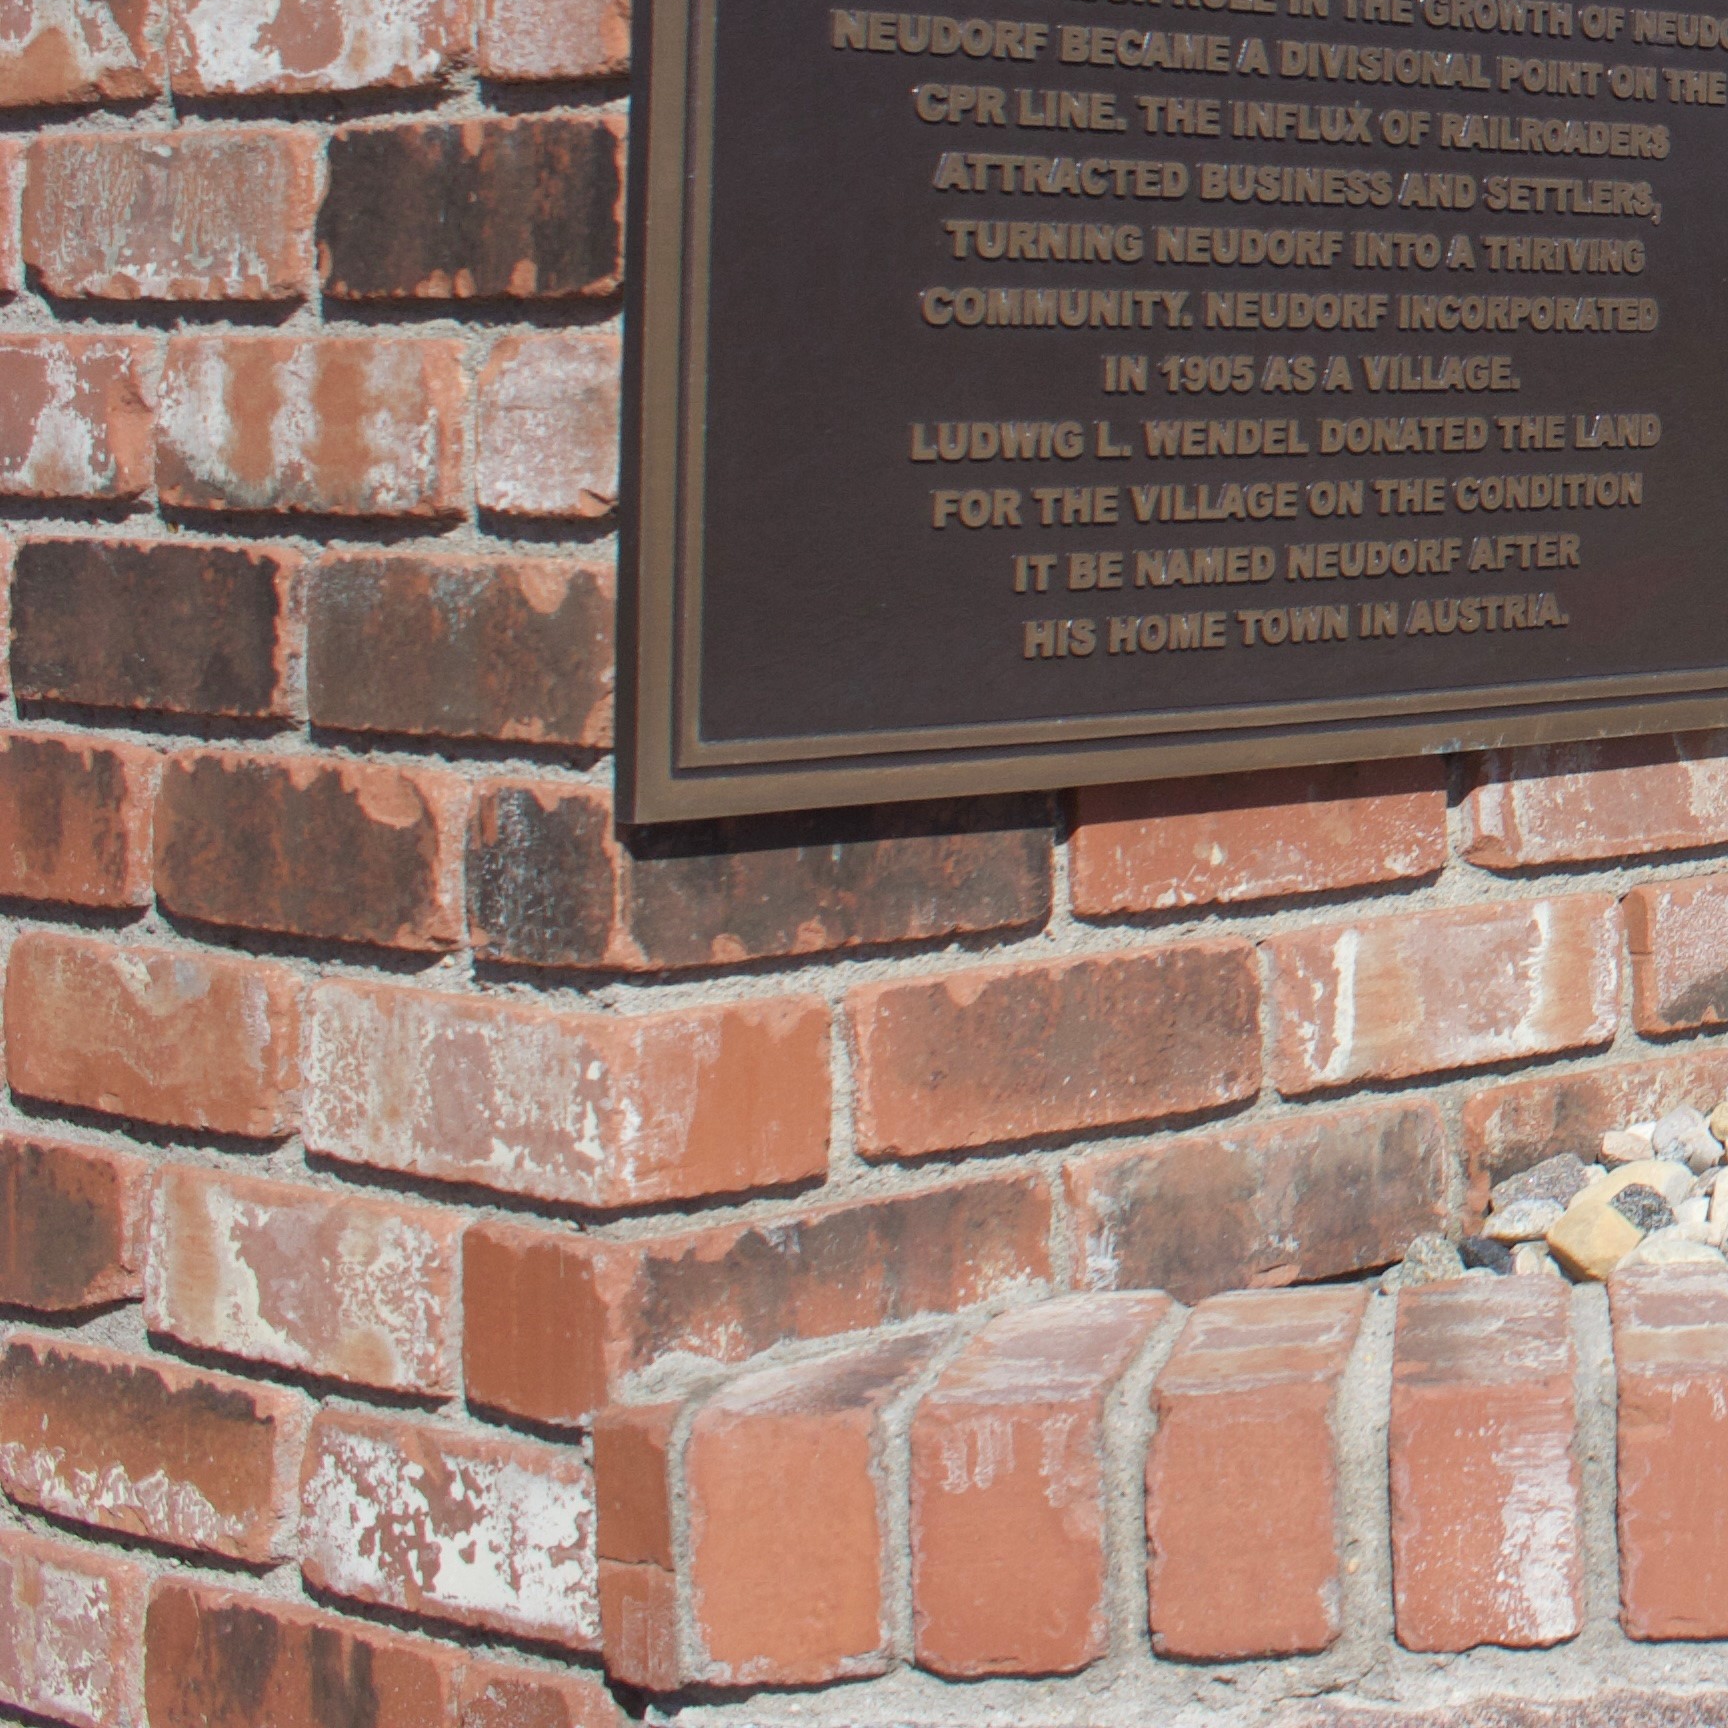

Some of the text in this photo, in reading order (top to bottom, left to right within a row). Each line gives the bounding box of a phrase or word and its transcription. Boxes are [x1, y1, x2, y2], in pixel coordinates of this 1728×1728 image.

[1579, 9, 1625, 40] OF
[830, 10, 1727, 105] NEUDORF BECAME A DIVISIONAL POINT ON THE
[914, 84, 1670, 159] CPR LINE. THE INFLUX OF RAILROADERS
[933, 153, 1662, 224] ATTRACTED BUSINESS AND SETTLERS,
[945, 220, 1646, 273] TURNING NEUDORF INTO A THRIVING
[920, 287, 1659, 332] COMMUNITY. NEUDORF INCORPORATED
[1103, 355, 1521, 393] IN 1905 AS A VILLAGE.
[911, 414, 1661, 462] LUDWIG L. WENDEL DONATED THE LAND
[932, 473, 1643, 530] FOR THE VILLAGE ON THE CONDITION
[1013, 533, 1580, 594] IT BE NAMED NEUDORF AFTER
[1023, 593, 1570, 658] HIS HOME TOWN IN AUSTRIA.
